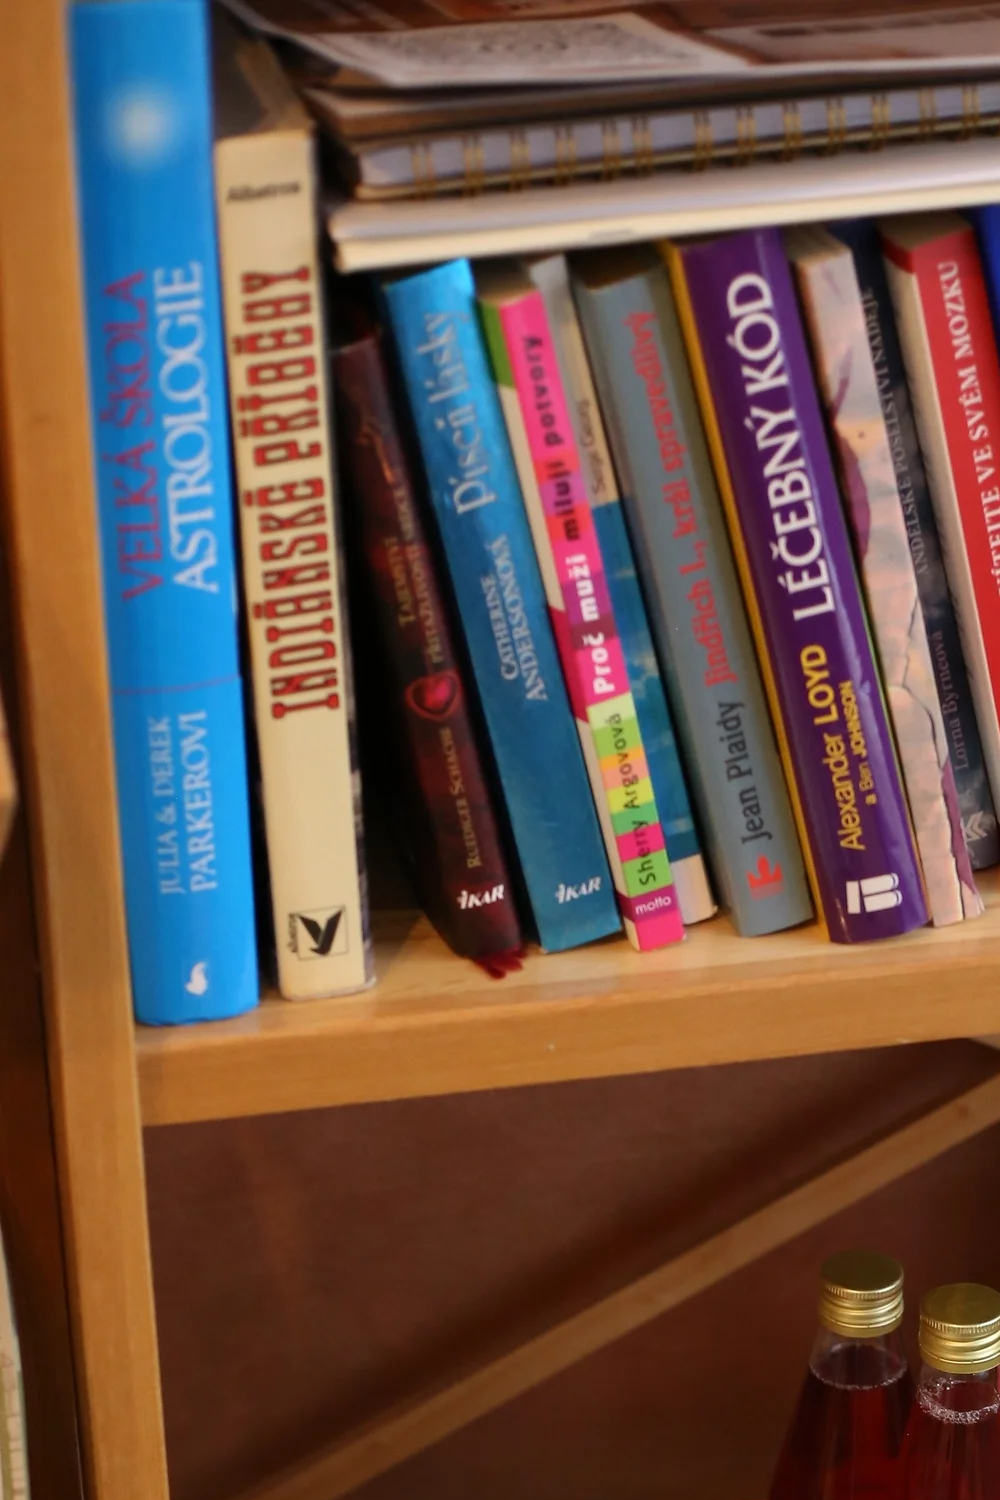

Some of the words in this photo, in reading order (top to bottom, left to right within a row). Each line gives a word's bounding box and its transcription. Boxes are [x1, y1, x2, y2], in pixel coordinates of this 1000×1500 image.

[101, 270, 154, 428] ŠKOLA
[726, 272, 791, 396] KÓD
[936, 260, 974, 361] MOZKU
[233, 266, 323, 467] PŘÍBĚHY
[523, 334, 565, 448] potvory
[623, 311, 689, 474] spravedlivý
[956, 364, 990, 442] SVÉM
[153, 261, 220, 593] ASTROLOGIE
[973, 446, 995, 482] VE
[103, 441, 164, 601] VELKÁ
[662, 478, 698, 540] král
[743, 405, 836, 621] LÉČEBNÝ
[244, 476, 340, 720] INDIÁNSKÉ
[481, 575, 520, 681] CATHERINE
[566, 553, 600, 623] muži
[583, 631, 615, 696] Proč
[687, 580, 738, 688] Jindřich
[800, 644, 840, 726] LOYD
[838, 680, 868, 758] JOHNSON
[147, 716, 175, 797] DEREK
[605, 713, 641, 810] Argovová
[718, 701, 753, 783] Plaidy
[859, 765, 876, 792] Ben
[949, 718, 969, 770] Lorna
[155, 804, 177, 825] &
[178, 710, 218, 892] PARKEROVI
[741, 786, 773, 846] Jean
[823, 732, 866, 850] Alexander
[865, 793, 878, 806] a
[158, 829, 186, 895] JULIA
[631, 820, 657, 886] Sherry
[634, 895, 672, 916] motto
